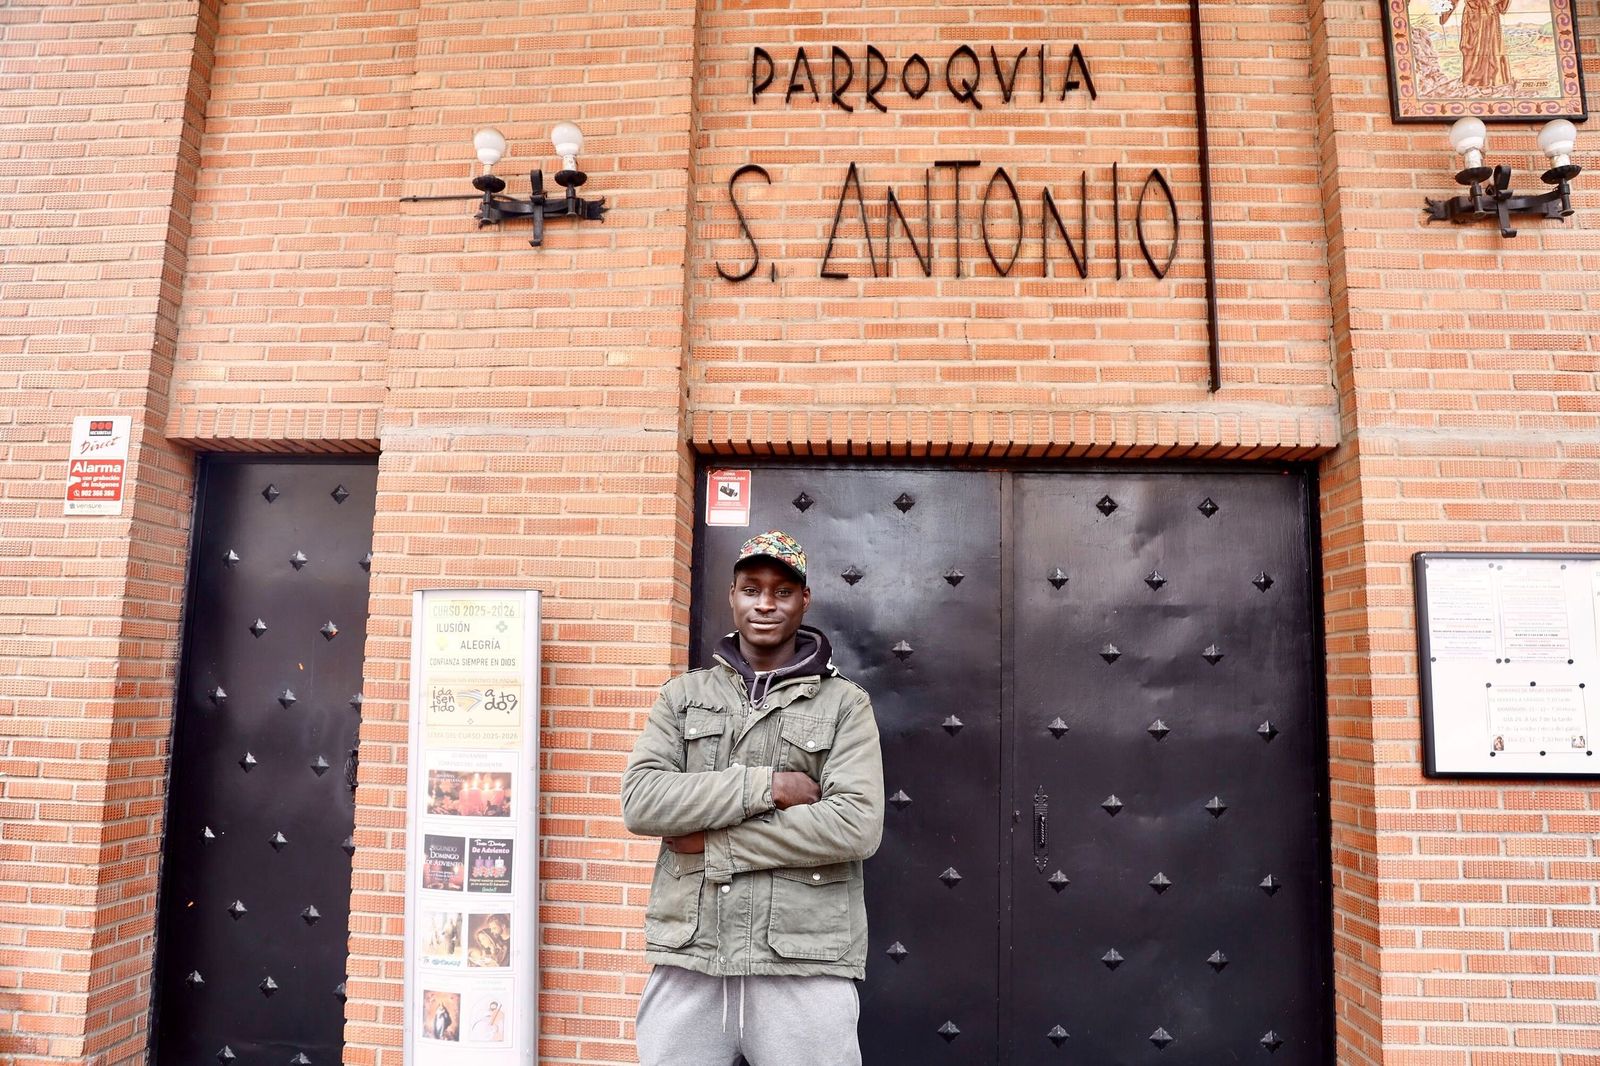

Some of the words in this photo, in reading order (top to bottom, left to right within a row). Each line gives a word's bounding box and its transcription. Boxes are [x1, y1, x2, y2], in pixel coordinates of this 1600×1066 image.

[753, 43, 1098, 112] PARROQVIA
[821, 160, 1180, 280] ANTONIO
[80, 436, 121, 454] Direct
[71, 461, 121, 473] Alarma
[90, 481, 120, 489] imágenes
[433, 605, 461, 617] CURSO
[462, 604, 515, 617] 2025-2026
[436, 621, 471, 633] ILUSIÓN
[460, 638, 501, 650] ALEGRÍA
[429, 657, 460, 667] CONFIANZA
[461, 657, 489, 667] SIEMPRE
[490, 657, 499, 667] EN
[500, 658, 516, 667] DIOS
[429, 848, 460, 860] DOMINGO
